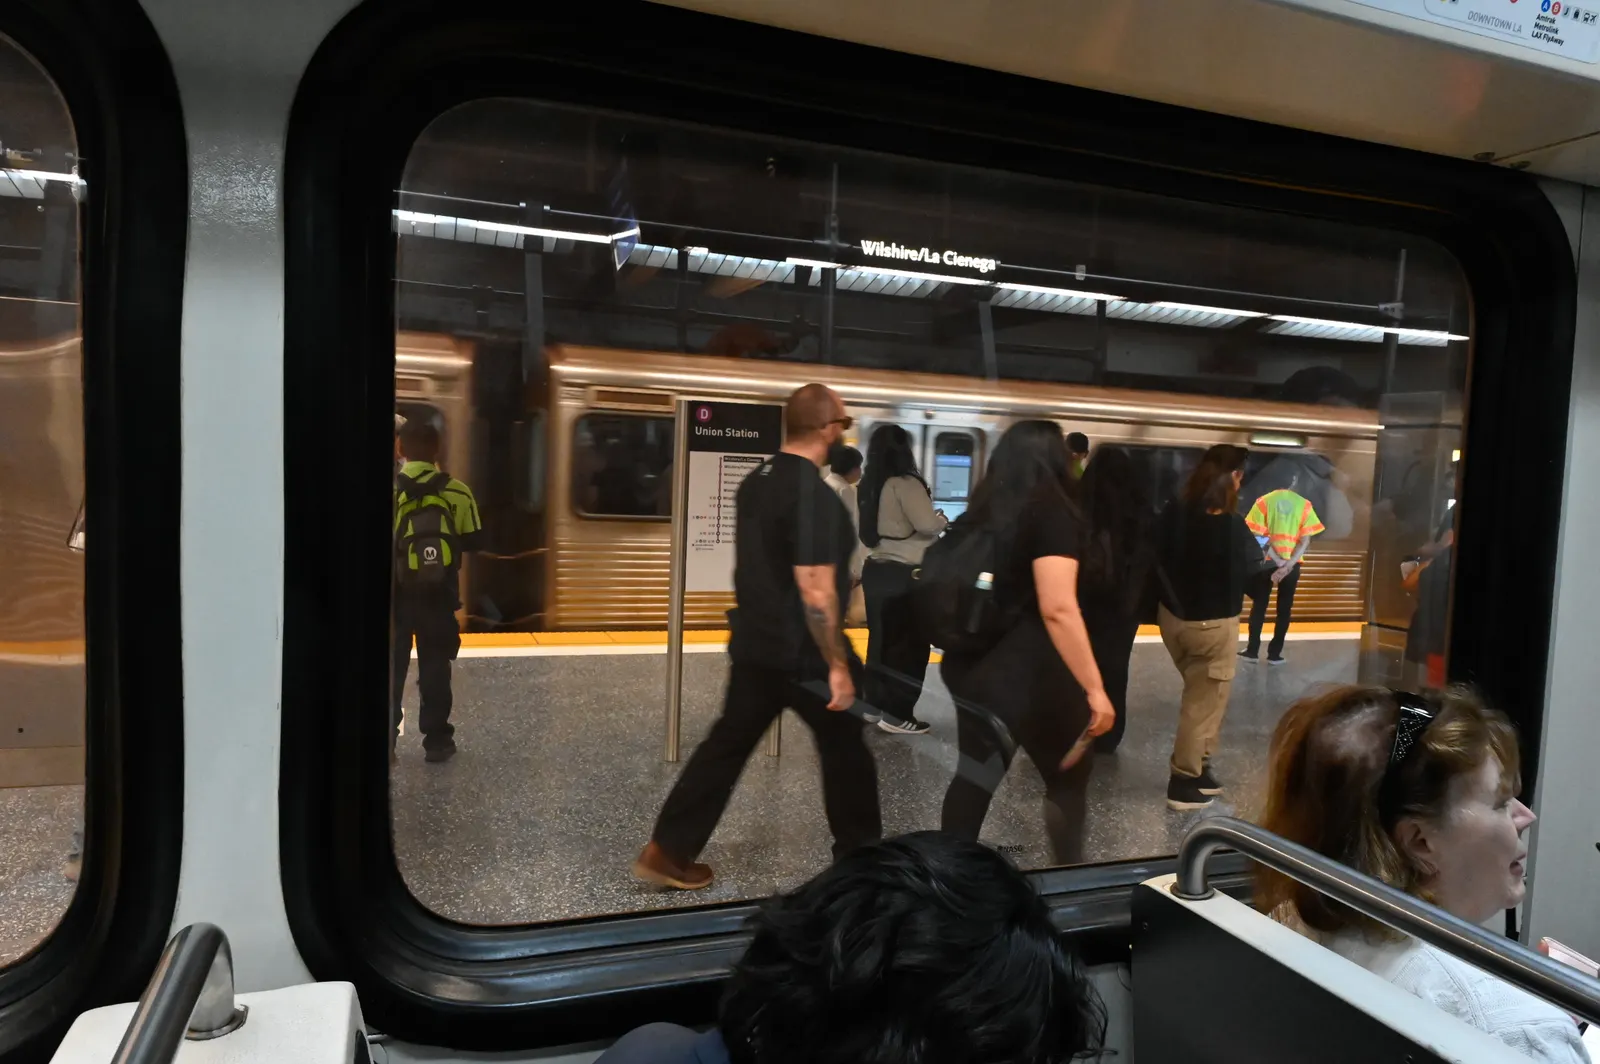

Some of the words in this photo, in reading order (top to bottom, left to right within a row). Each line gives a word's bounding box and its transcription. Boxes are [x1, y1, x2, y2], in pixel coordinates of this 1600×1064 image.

[1467, 10, 1512, 31] DOWNTOWN
[1512, 23, 1522, 34] LA
[1535, 13, 1557, 25] Amtrak
[1533, 21, 1560, 35] Metrolink
[1531, 30, 1543, 40] LAX
[1542, 32, 1565, 46] FlyAway
[860, 239, 941, 264] Wilshire/La
[942, 250, 997, 273] Cienega
[700, 408, 709, 420] D
[695, 426, 723, 437] Union
[725, 427, 759, 438] Station
